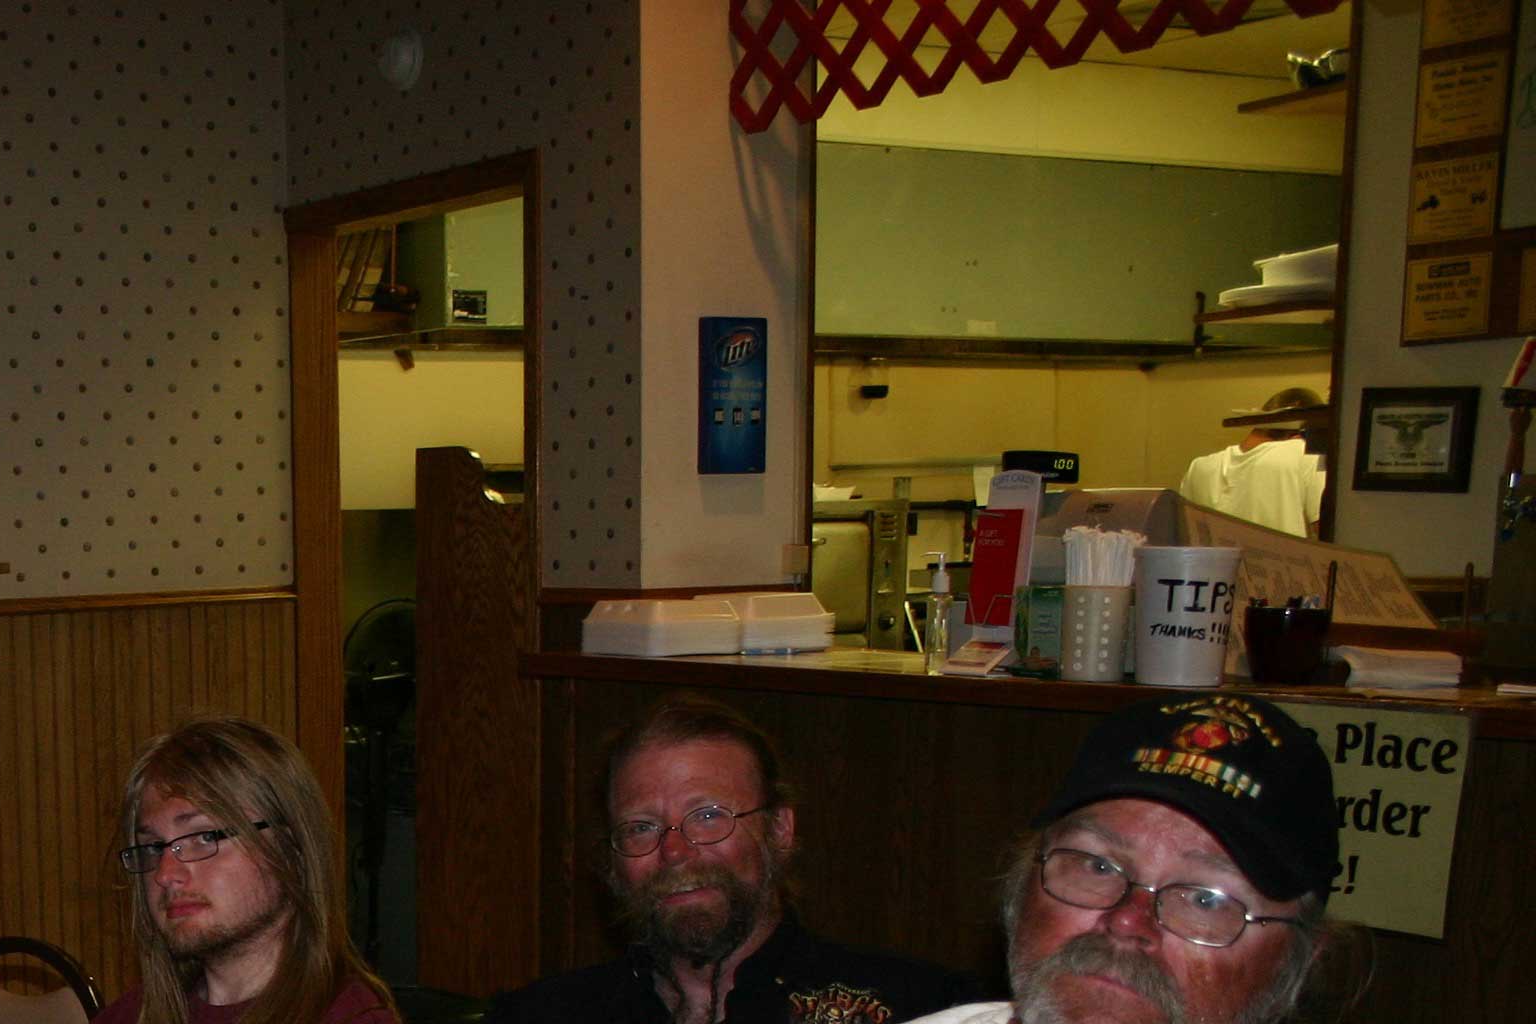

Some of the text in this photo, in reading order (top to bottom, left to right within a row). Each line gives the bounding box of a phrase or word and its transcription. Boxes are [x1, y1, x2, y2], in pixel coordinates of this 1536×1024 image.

[1157, 578, 1236, 613] TIPS
[1334, 721, 1459, 775] Place
[1336, 788, 1432, 839] rder
